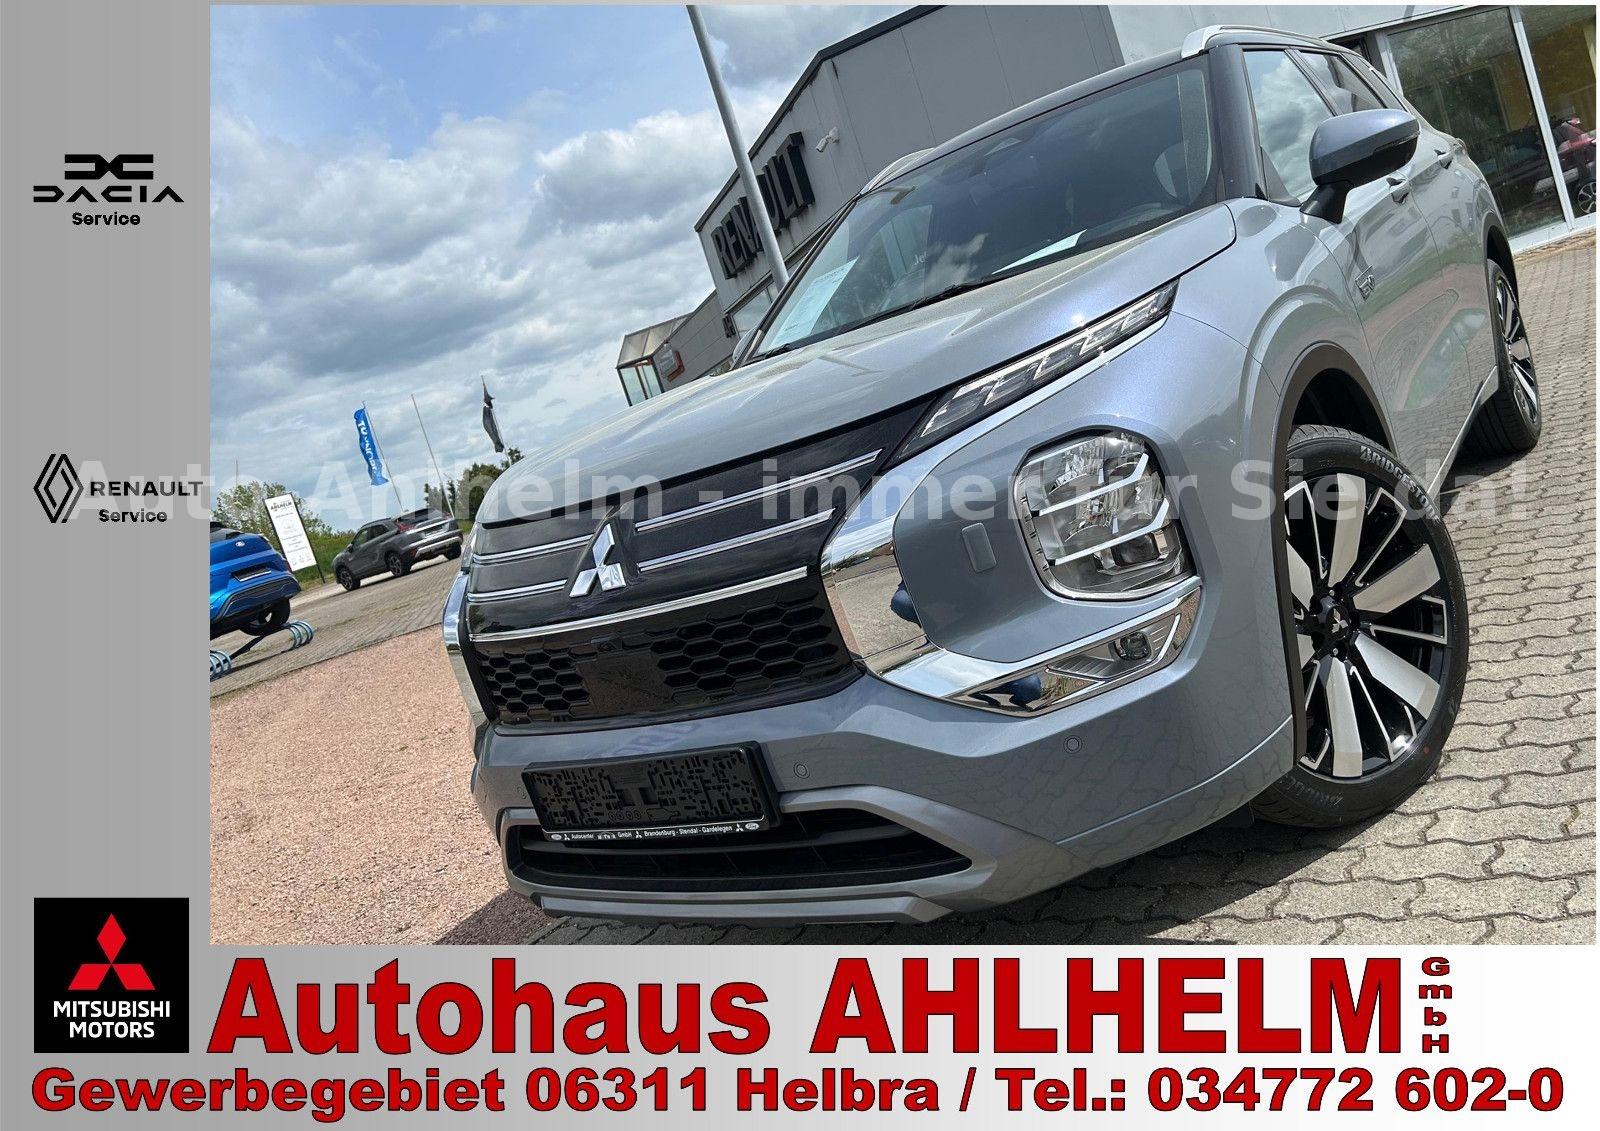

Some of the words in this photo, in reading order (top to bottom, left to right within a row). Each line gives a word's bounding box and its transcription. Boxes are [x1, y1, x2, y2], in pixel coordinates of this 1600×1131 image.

[1360, 446, 1442, 528] BRIDGESTONE
[643, 829, 676, 837] Brandenburg
[679, 826, 699, 835] Stendal
[701, 825, 733, 834] Gardelegen
